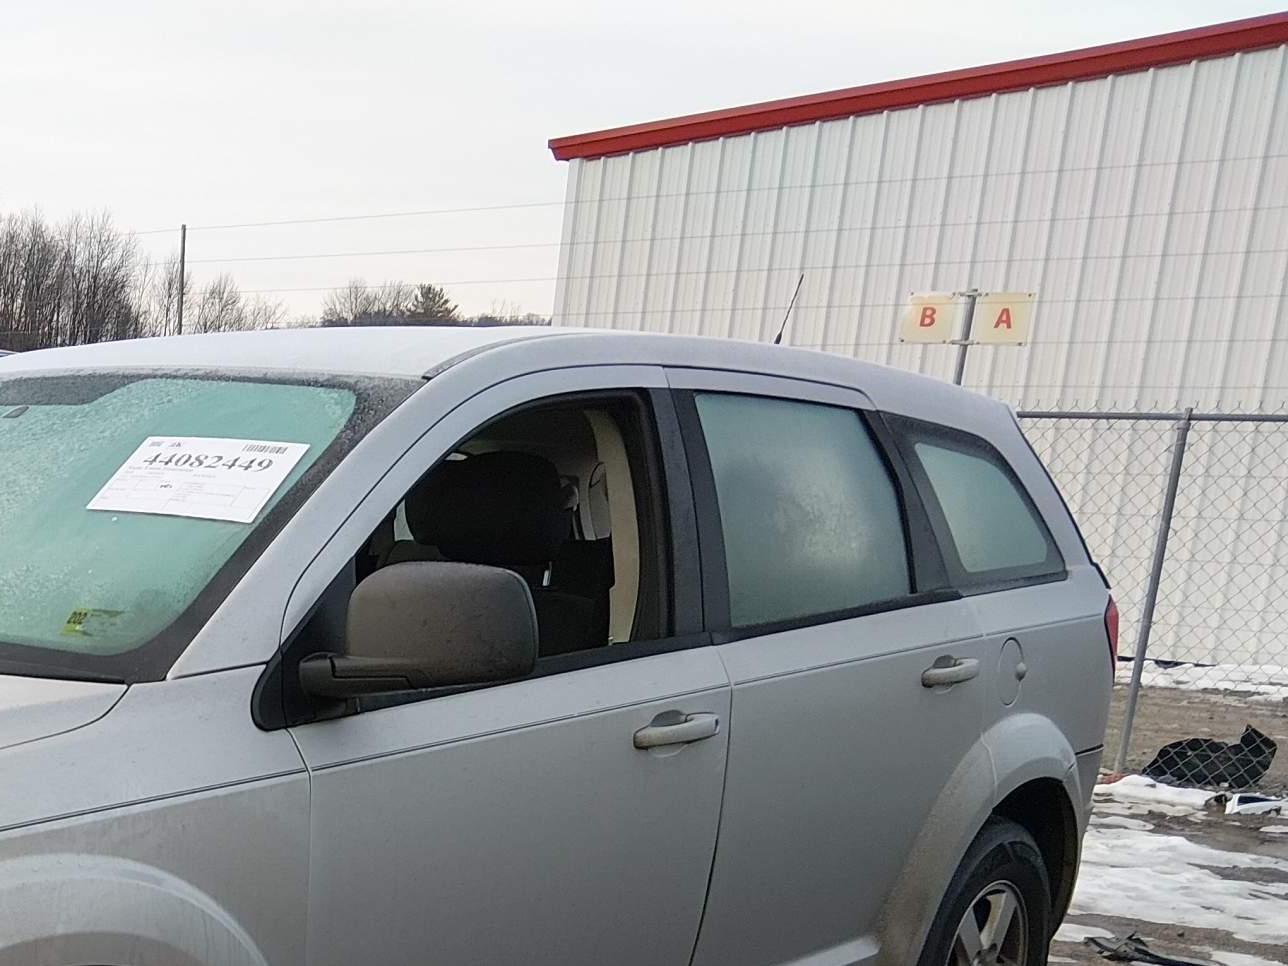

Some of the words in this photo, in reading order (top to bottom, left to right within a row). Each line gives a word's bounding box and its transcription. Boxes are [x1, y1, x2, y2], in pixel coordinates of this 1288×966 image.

[919, 306, 937, 328] B
[993, 307, 1013, 329] A
[143, 452, 274, 473] 44082449
